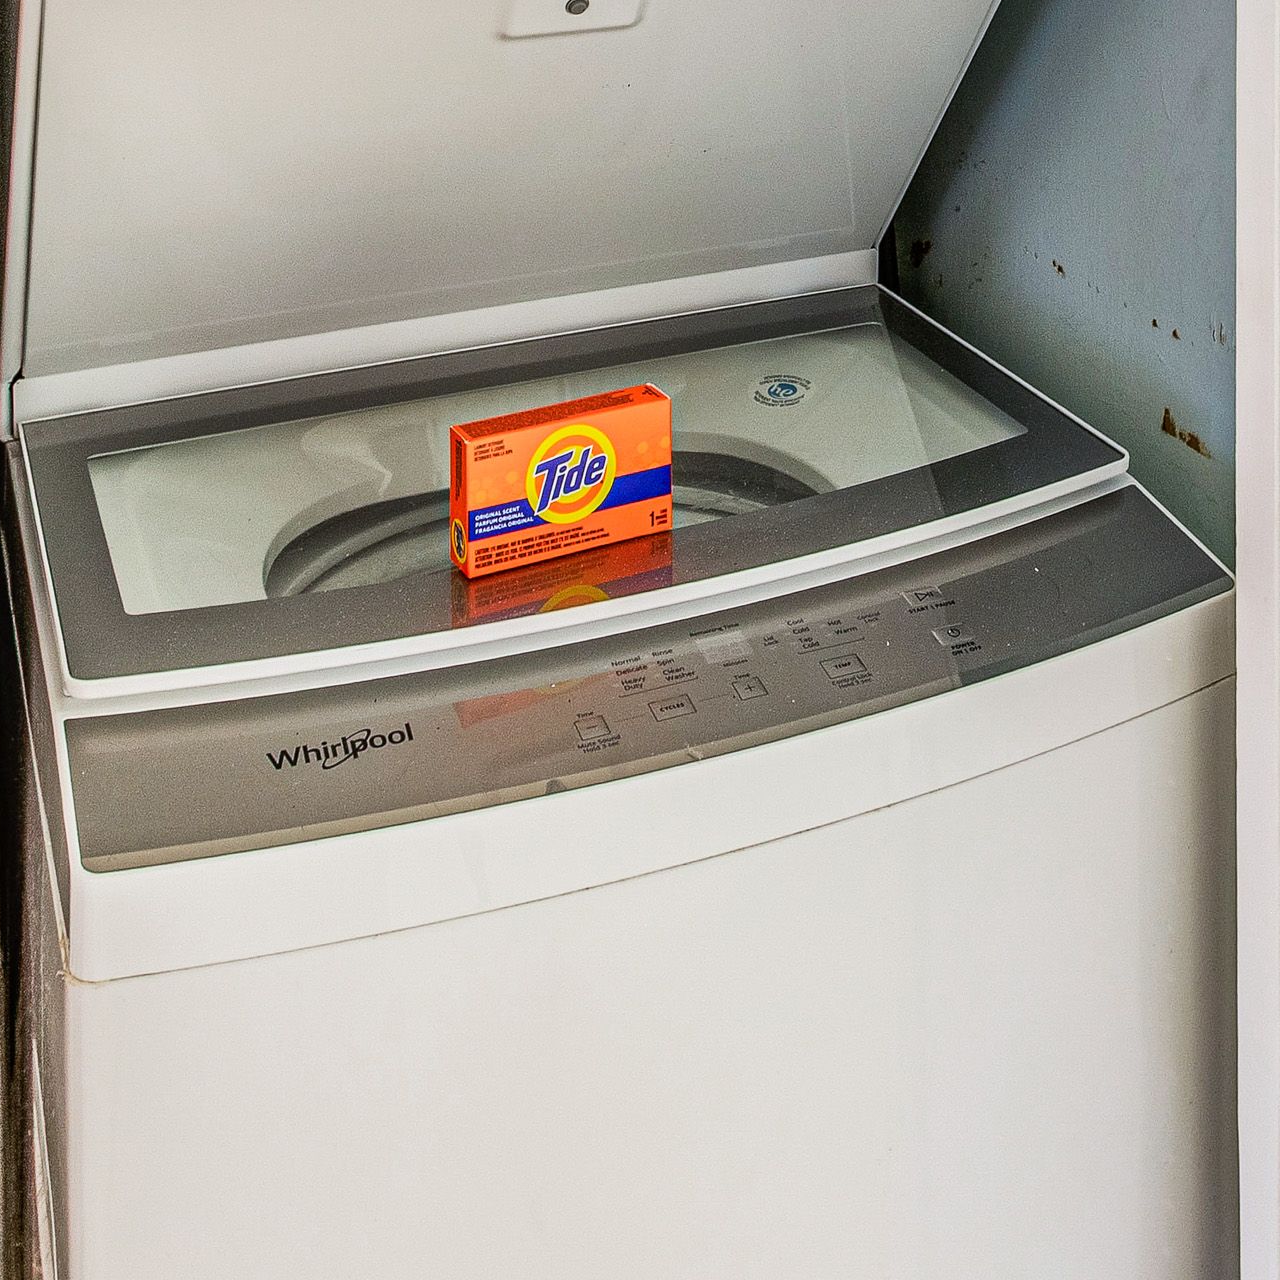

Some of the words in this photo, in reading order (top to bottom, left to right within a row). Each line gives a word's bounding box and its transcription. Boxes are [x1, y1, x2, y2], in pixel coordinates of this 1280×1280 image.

[534, 444, 607, 516] Tide
[475, 510, 501, 521] ORIGINAL
[503, 506, 520, 515] SCENT
[475, 519, 498, 528] PARFUM
[498, 512, 524, 522] ORIGINAL
[508, 517, 533, 527] ORIGINAL
[834, 626, 858, 635] Warm
[611, 656, 641, 667] Normal
[266, 722, 414, 770] Whirlpool
